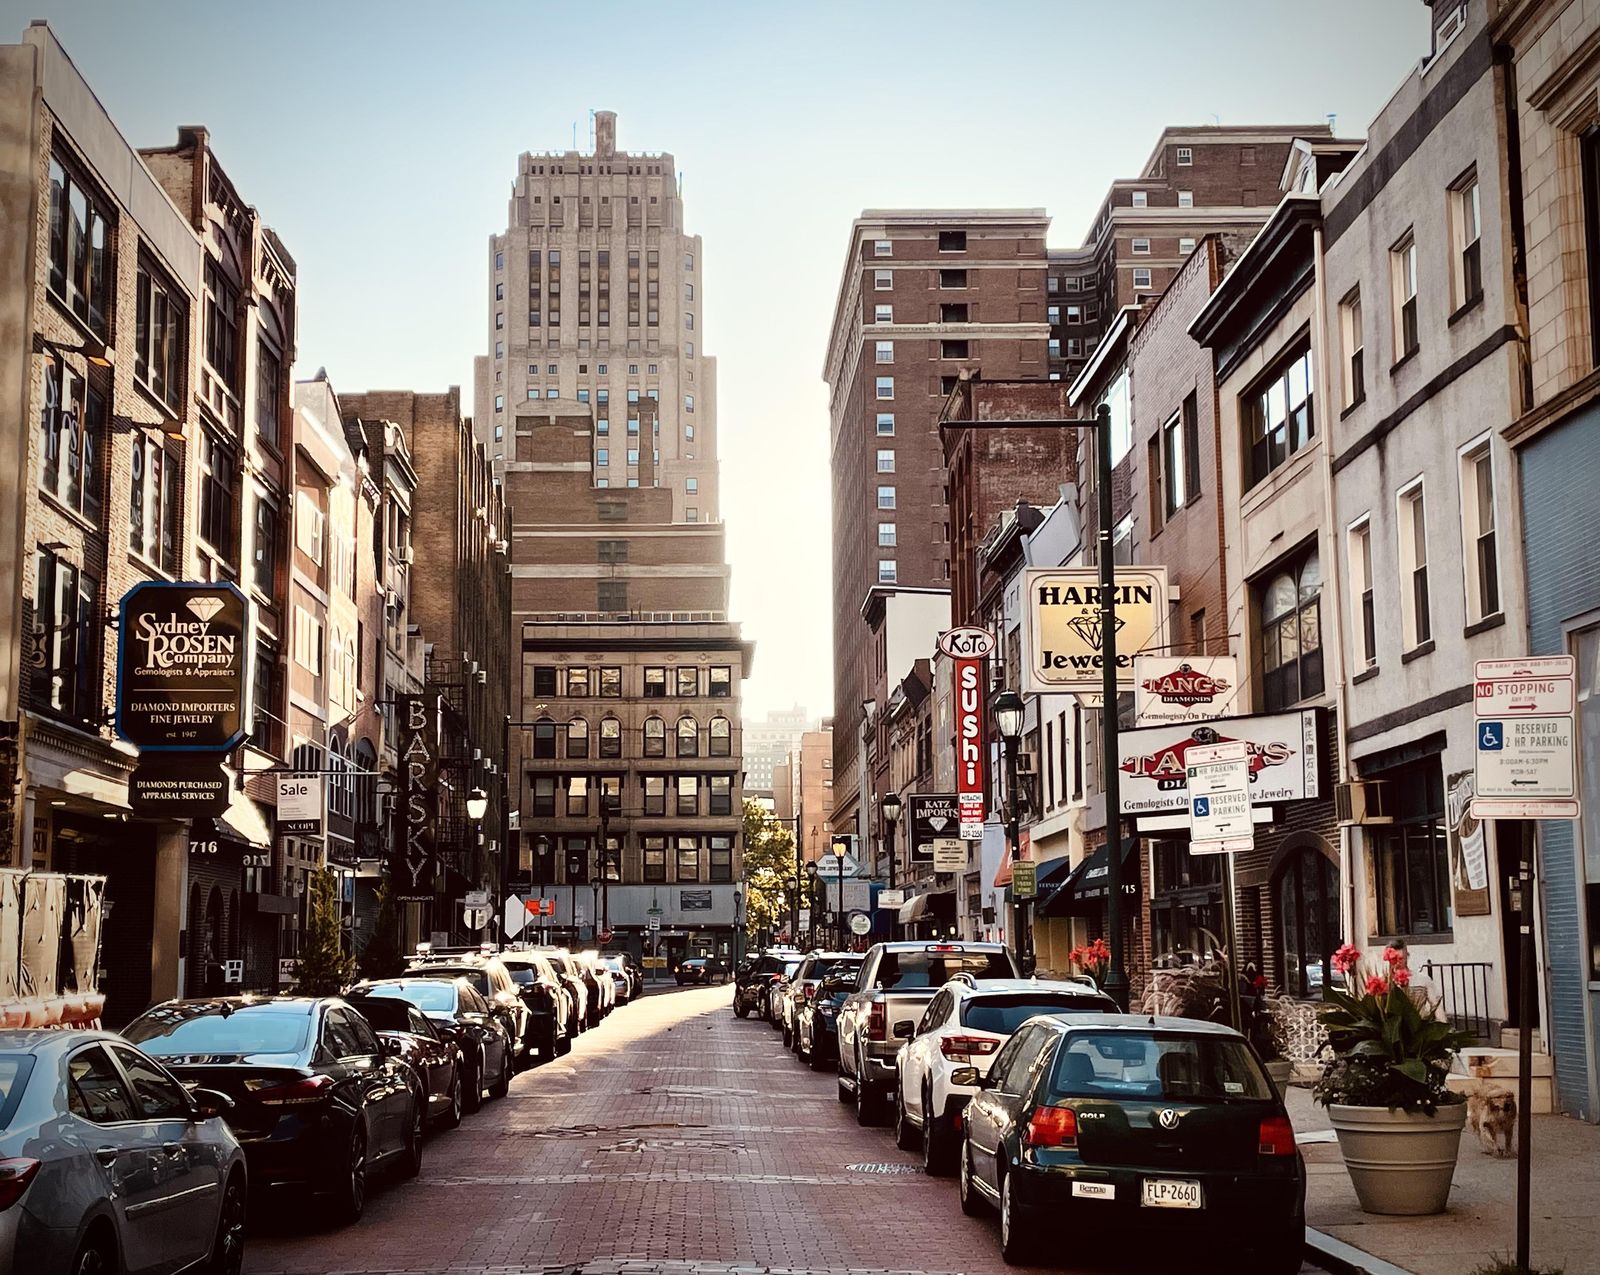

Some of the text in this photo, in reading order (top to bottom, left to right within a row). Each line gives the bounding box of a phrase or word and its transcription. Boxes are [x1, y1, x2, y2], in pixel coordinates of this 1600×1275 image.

[135, 612, 210, 641] Sydney
[146, 635, 236, 668] ROSEN
[161, 650, 235, 668] Company
[1042, 650, 1156, 669] Jeweer
[134, 667, 235, 678] Gemologists & Appraisers
[1477, 682, 1555, 697] NO STOPPING
[131, 702, 236, 712] DIAMOND IMPORTERS
[150, 714, 215, 725] FINE JEWELRY
[1515, 722, 1558, 734] RESERVED
[1505, 735, 1569, 748] 2 HR PARKING
[1210, 764, 1239, 774] PARKING
[137, 781, 223, 789] DIAMONDS PURCHASED
[280, 783, 308, 795] Sale
[141, 792, 215, 800] APPRAISAL SERVICES
[403, 700, 431, 887] BARSKY
[1210, 793, 1247, 805] RESERVED
[1259, 787, 1293, 800] Jewelry
[1124, 796, 1189, 811] Gemologists On
[916, 808, 959, 819] IMPORTS
[1213, 804, 1246, 816] PARKING
[190, 841, 218, 853] 716
[1080, 1112, 1106, 1120] GOLF
